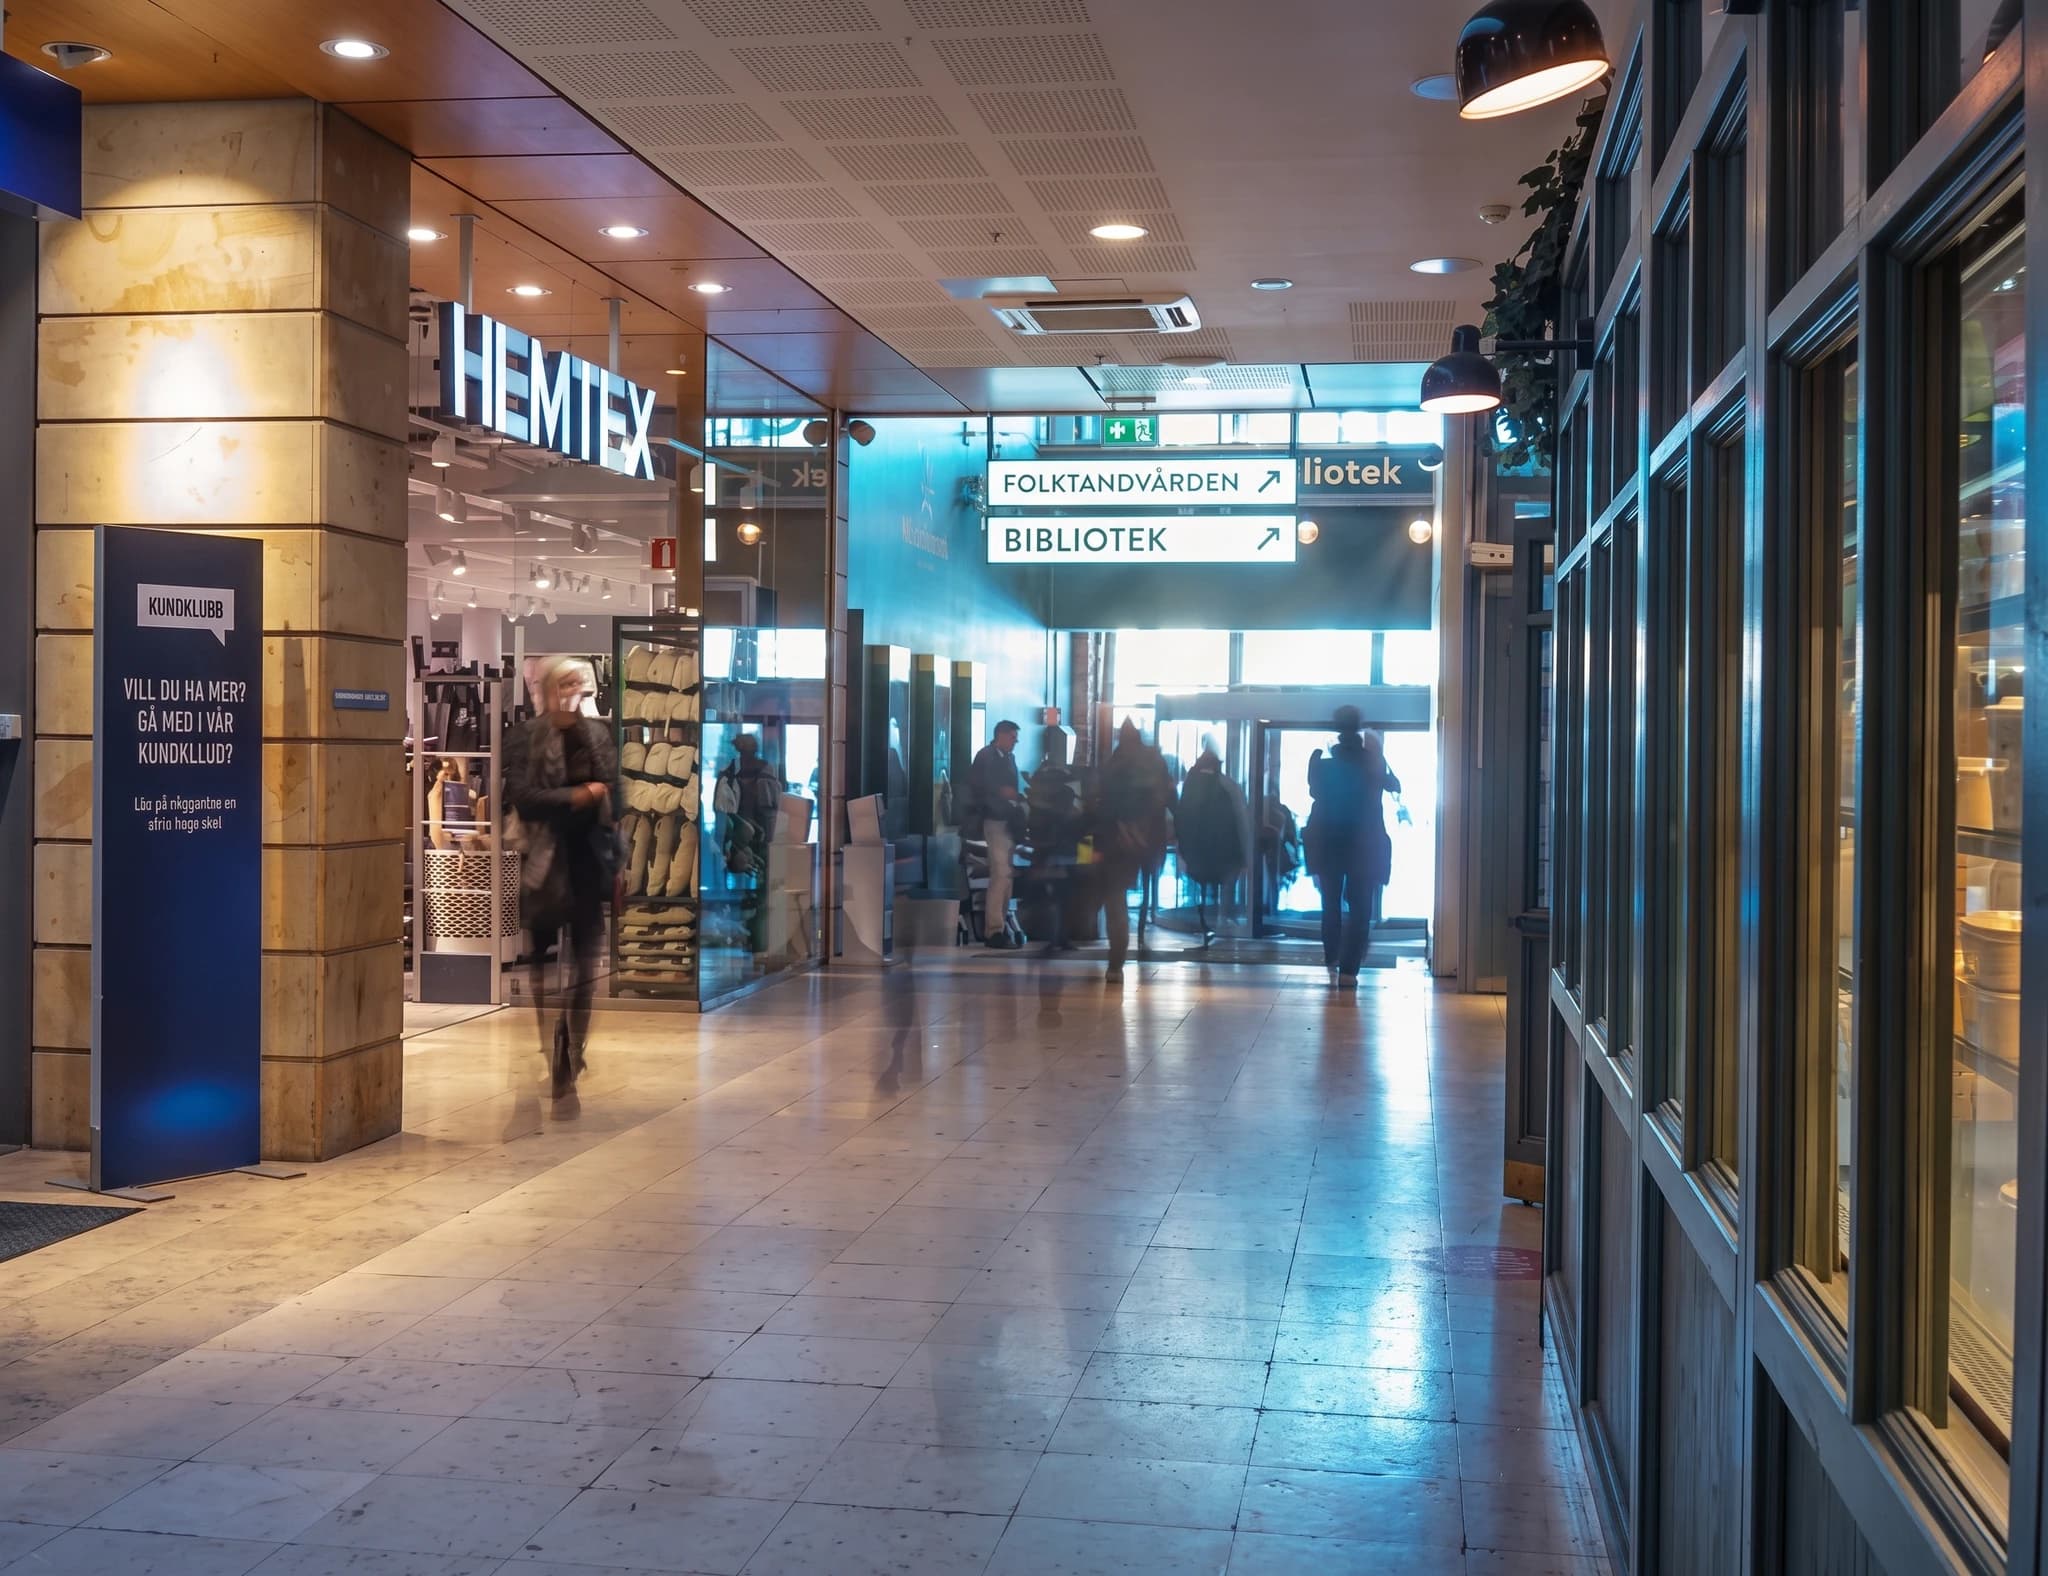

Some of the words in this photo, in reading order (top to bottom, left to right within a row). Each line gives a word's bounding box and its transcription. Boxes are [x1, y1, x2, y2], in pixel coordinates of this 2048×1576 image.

[440, 301, 656, 481] HEMTEX
[1003, 467, 1239, 493] FOLKTANDVÅRDEN
[1303, 456, 1402, 485] liotek
[1005, 527, 1168, 553] BIBLIOTEK
[148, 597, 224, 619] KUNDKLUBB
[123, 677, 156, 701] VILL
[160, 679, 180, 702] DU
[185, 680, 205, 702] HA
[208, 681, 247, 703] MER?
[137, 704, 158, 733] GÅ
[162, 711, 193, 733] MED
[198, 711, 202, 733] I
[206, 705, 234, 733] VÅR
[224, 798, 237, 810] en
